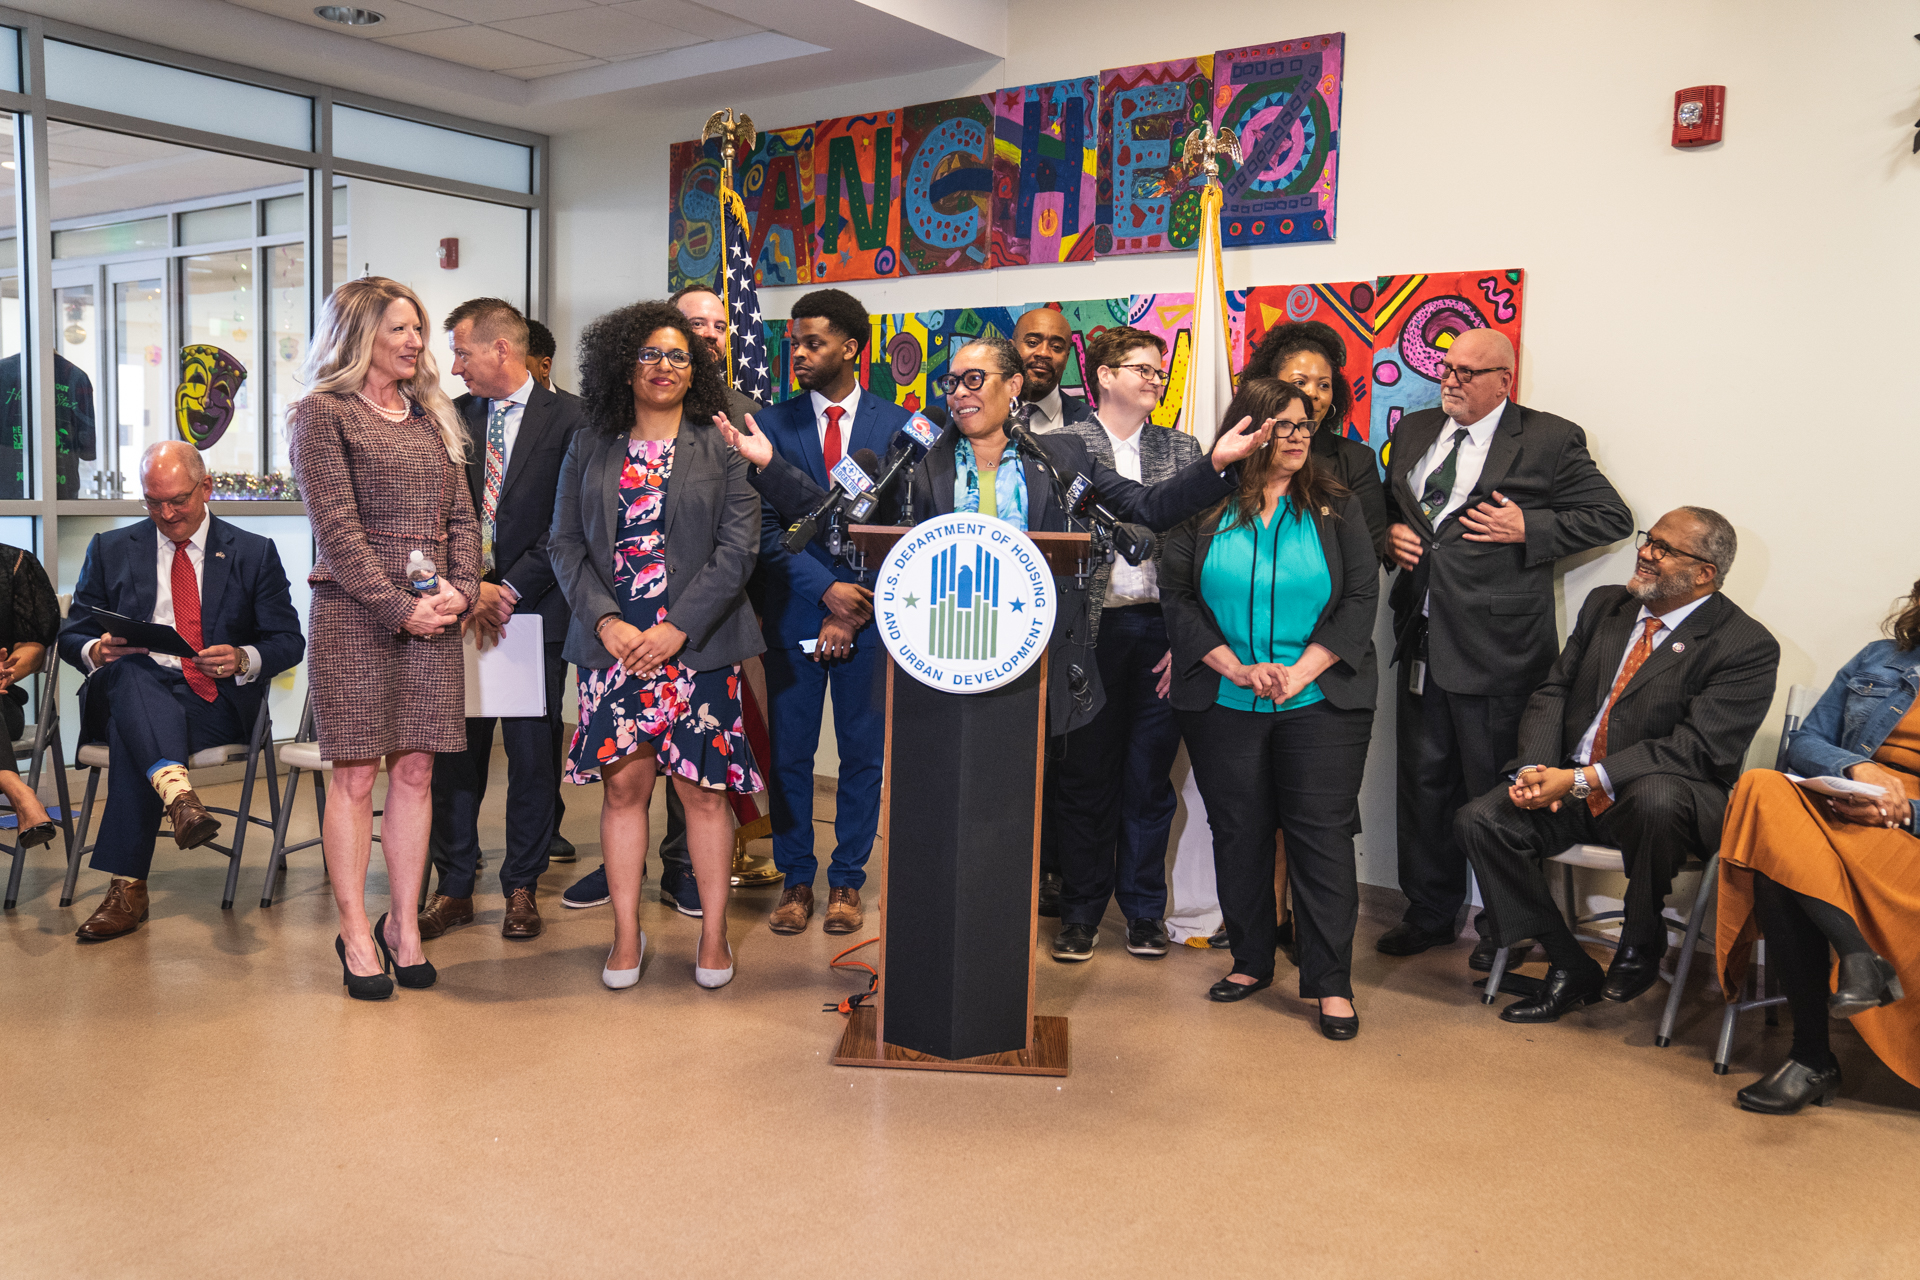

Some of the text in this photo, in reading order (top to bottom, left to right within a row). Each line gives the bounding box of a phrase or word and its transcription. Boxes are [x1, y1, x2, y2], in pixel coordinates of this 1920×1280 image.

[677, 52, 1322, 285] SANCHEZ
[906, 425, 931, 446] WDSU
[835, 468, 850, 485] LOCAL
[840, 457, 864, 484] FOX
[883, 523, 1046, 608] U.S. DEPARTMENT OF HOUSING
[883, 611, 1043, 685] AND URBAN DEVELOPMENT
